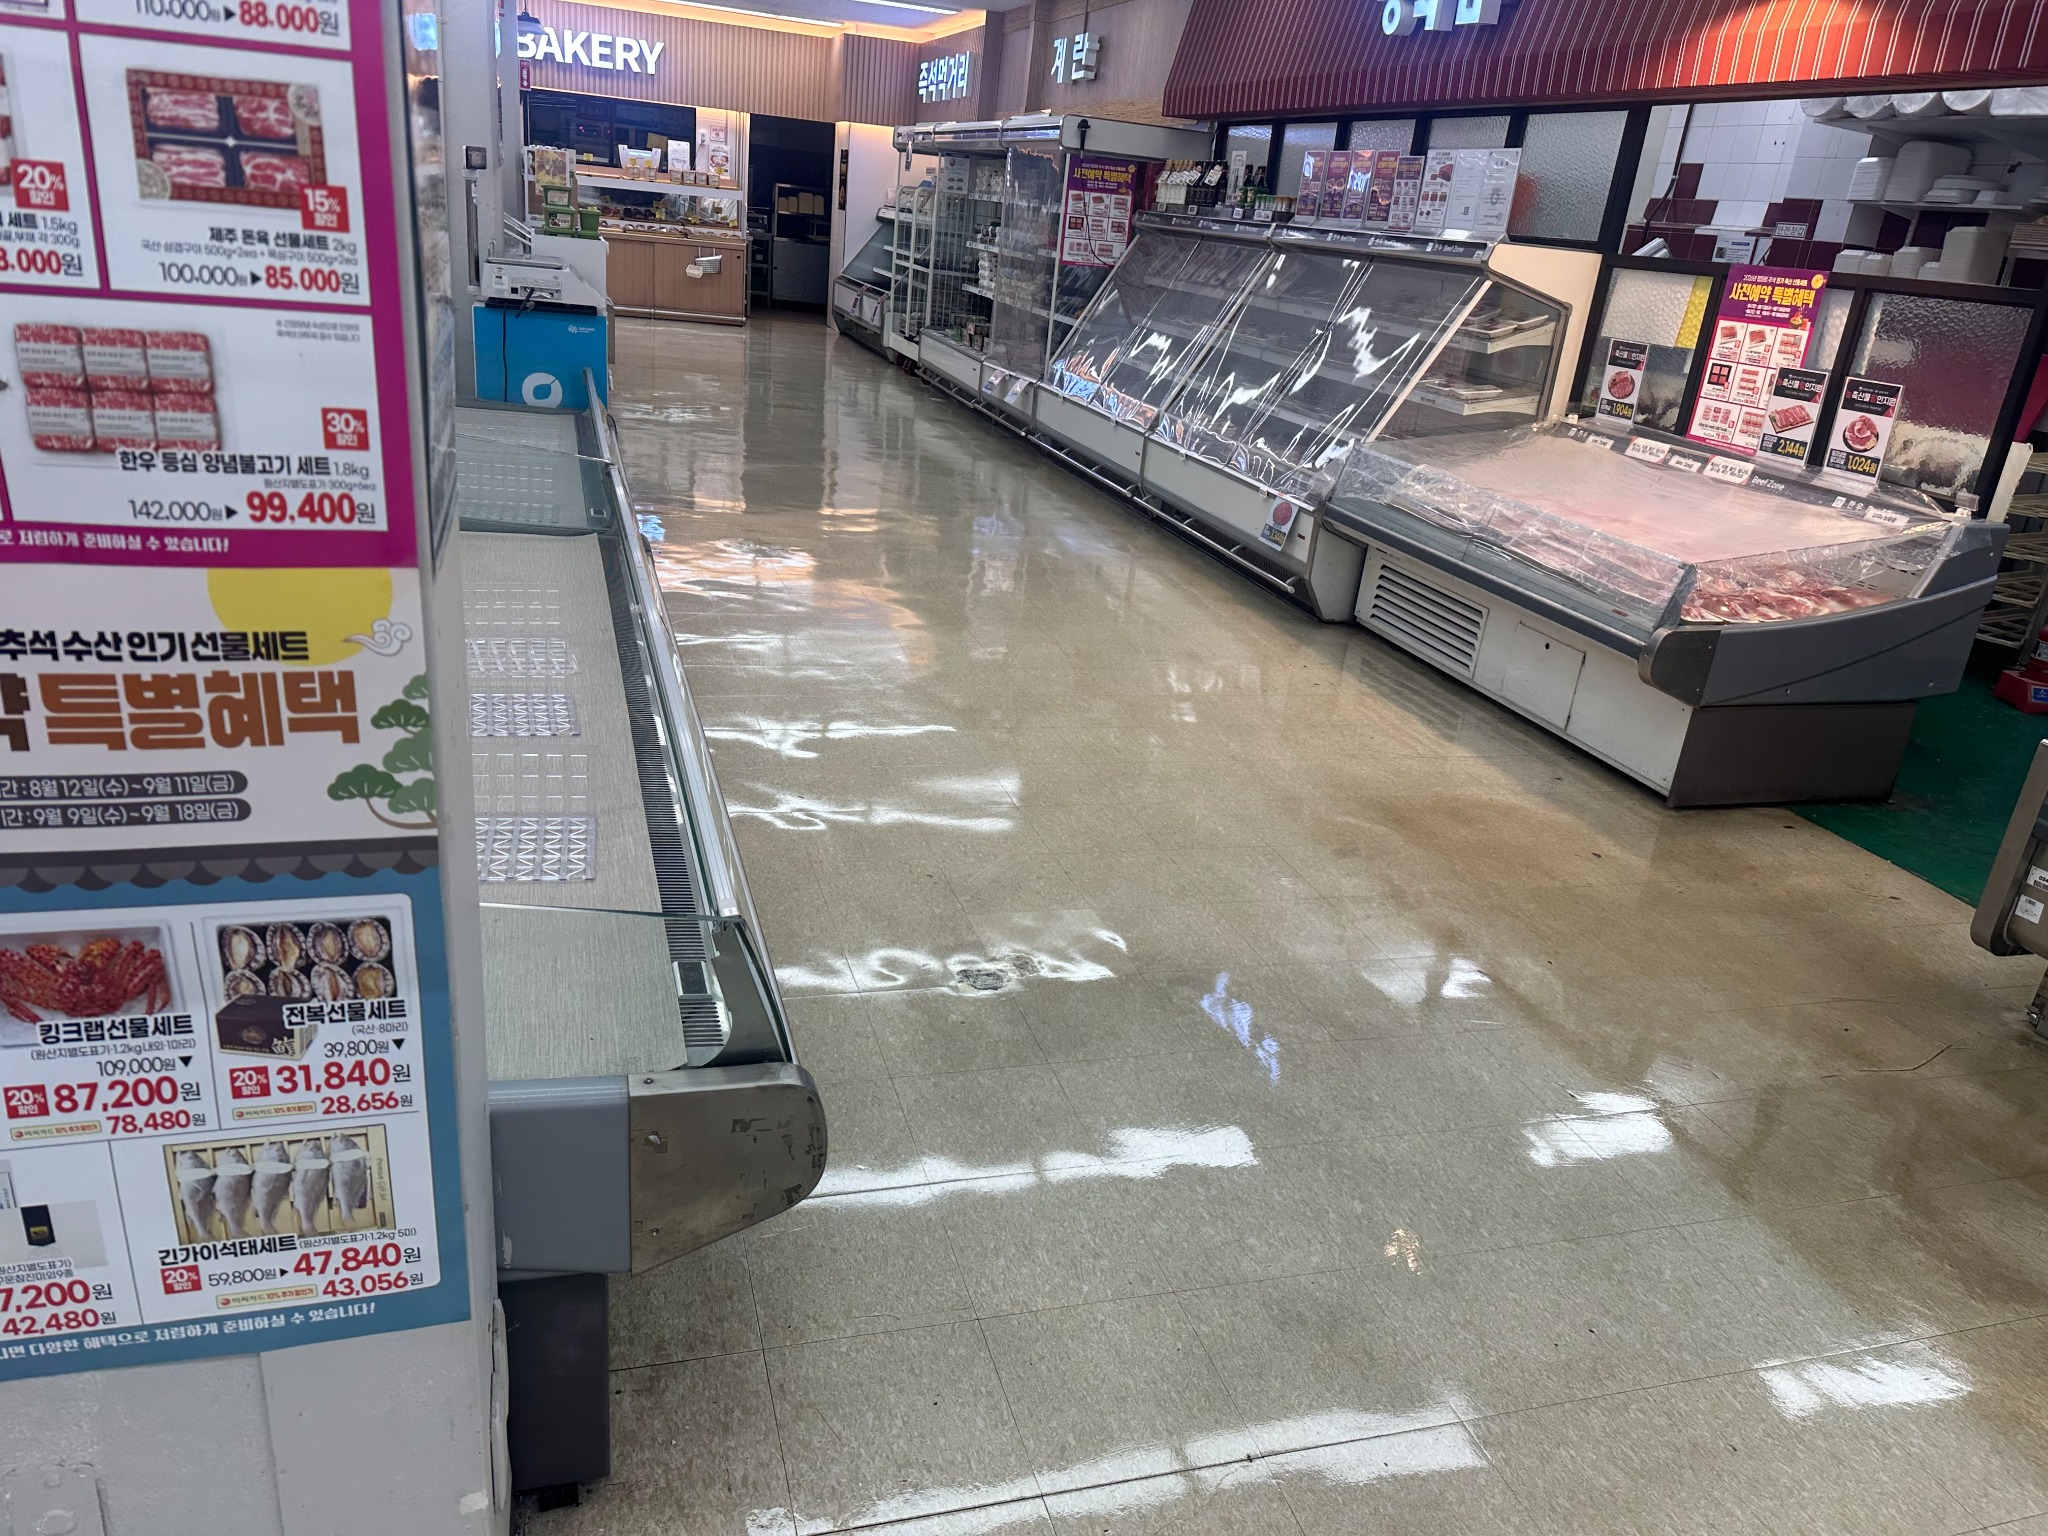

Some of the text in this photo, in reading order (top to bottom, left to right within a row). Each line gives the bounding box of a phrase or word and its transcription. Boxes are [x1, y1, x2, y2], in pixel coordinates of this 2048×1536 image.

[918, 51, 970, 104] 즉석먹거리
[17, 163, 65, 191] 20%
[28, 189, 56, 206] 할인
[304, 189, 342, 213] 15%
[8, 212, 79, 236] 세트 1.5kg
[314, 212, 338, 228] 할인
[1777, 224, 1805, 237] 안전장갑
[208, 226, 238, 244] 제주
[274, 231, 330, 250] 선물세트
[331, 238, 358, 255] 2kg
[1729, 282, 1816, 309] 사전예약 특별혜택
[326, 412, 365, 434] 30%
[335, 434, 358, 447] 할인
[1777, 439, 1805, 457] 2,144원
[119, 450, 370, 480] 한우 등심 양념불고기 세트 1.8kg
[1847, 454, 1878, 474] 1,024원
[1751, 475, 1785, 491] Beef Zone
[128, 490, 376, 525] 142,000원 99,400원
[18, 529, 80, 547] 저렴하게
[82, 532, 142, 550] 준비하실
[146, 536, 161, 551] 수
[163, 535, 230, 553] 있습니다!
[0, 628, 310, 662] 추석 수산 인기 선물세트
[37, 669, 361, 751] 특별혜택
[323, 1039, 390, 1059] 39,800원
[96, 1056, 177, 1077] 109,000원
[231, 1070, 268, 1087] 20%
[276, 1057, 412, 1095] 31,840원
[7, 1088, 46, 1107] 20%
[53, 1075, 202, 1114] 87,200원
[240, 1084, 261, 1096] 할인
[16, 1104, 39, 1116] 할인
[320, 1090, 414, 1116] 28,656원
[106, 1109, 207, 1135] 78,480원
[158, 1233, 298, 1266] 긴가이석태세트
[292, 1242, 422, 1277] 47,840원
[164, 1269, 198, 1284] 20%
[172, 1281, 193, 1291] 할인
[207, 1266, 278, 1288] 59,800원
[322, 1271, 425, 1299] 43,056원
[2, 1308, 117, 1336] 42,480원
[29, 1338, 81, 1357] 다양한
[83, 1331, 150, 1350] 혜택으로
[154, 1322, 220, 1342] 저렴하게
[222, 1314, 287, 1334] 준비하실
[289, 1313, 306, 1326] 수
[309, 1301, 376, 1324] 있습니다!
